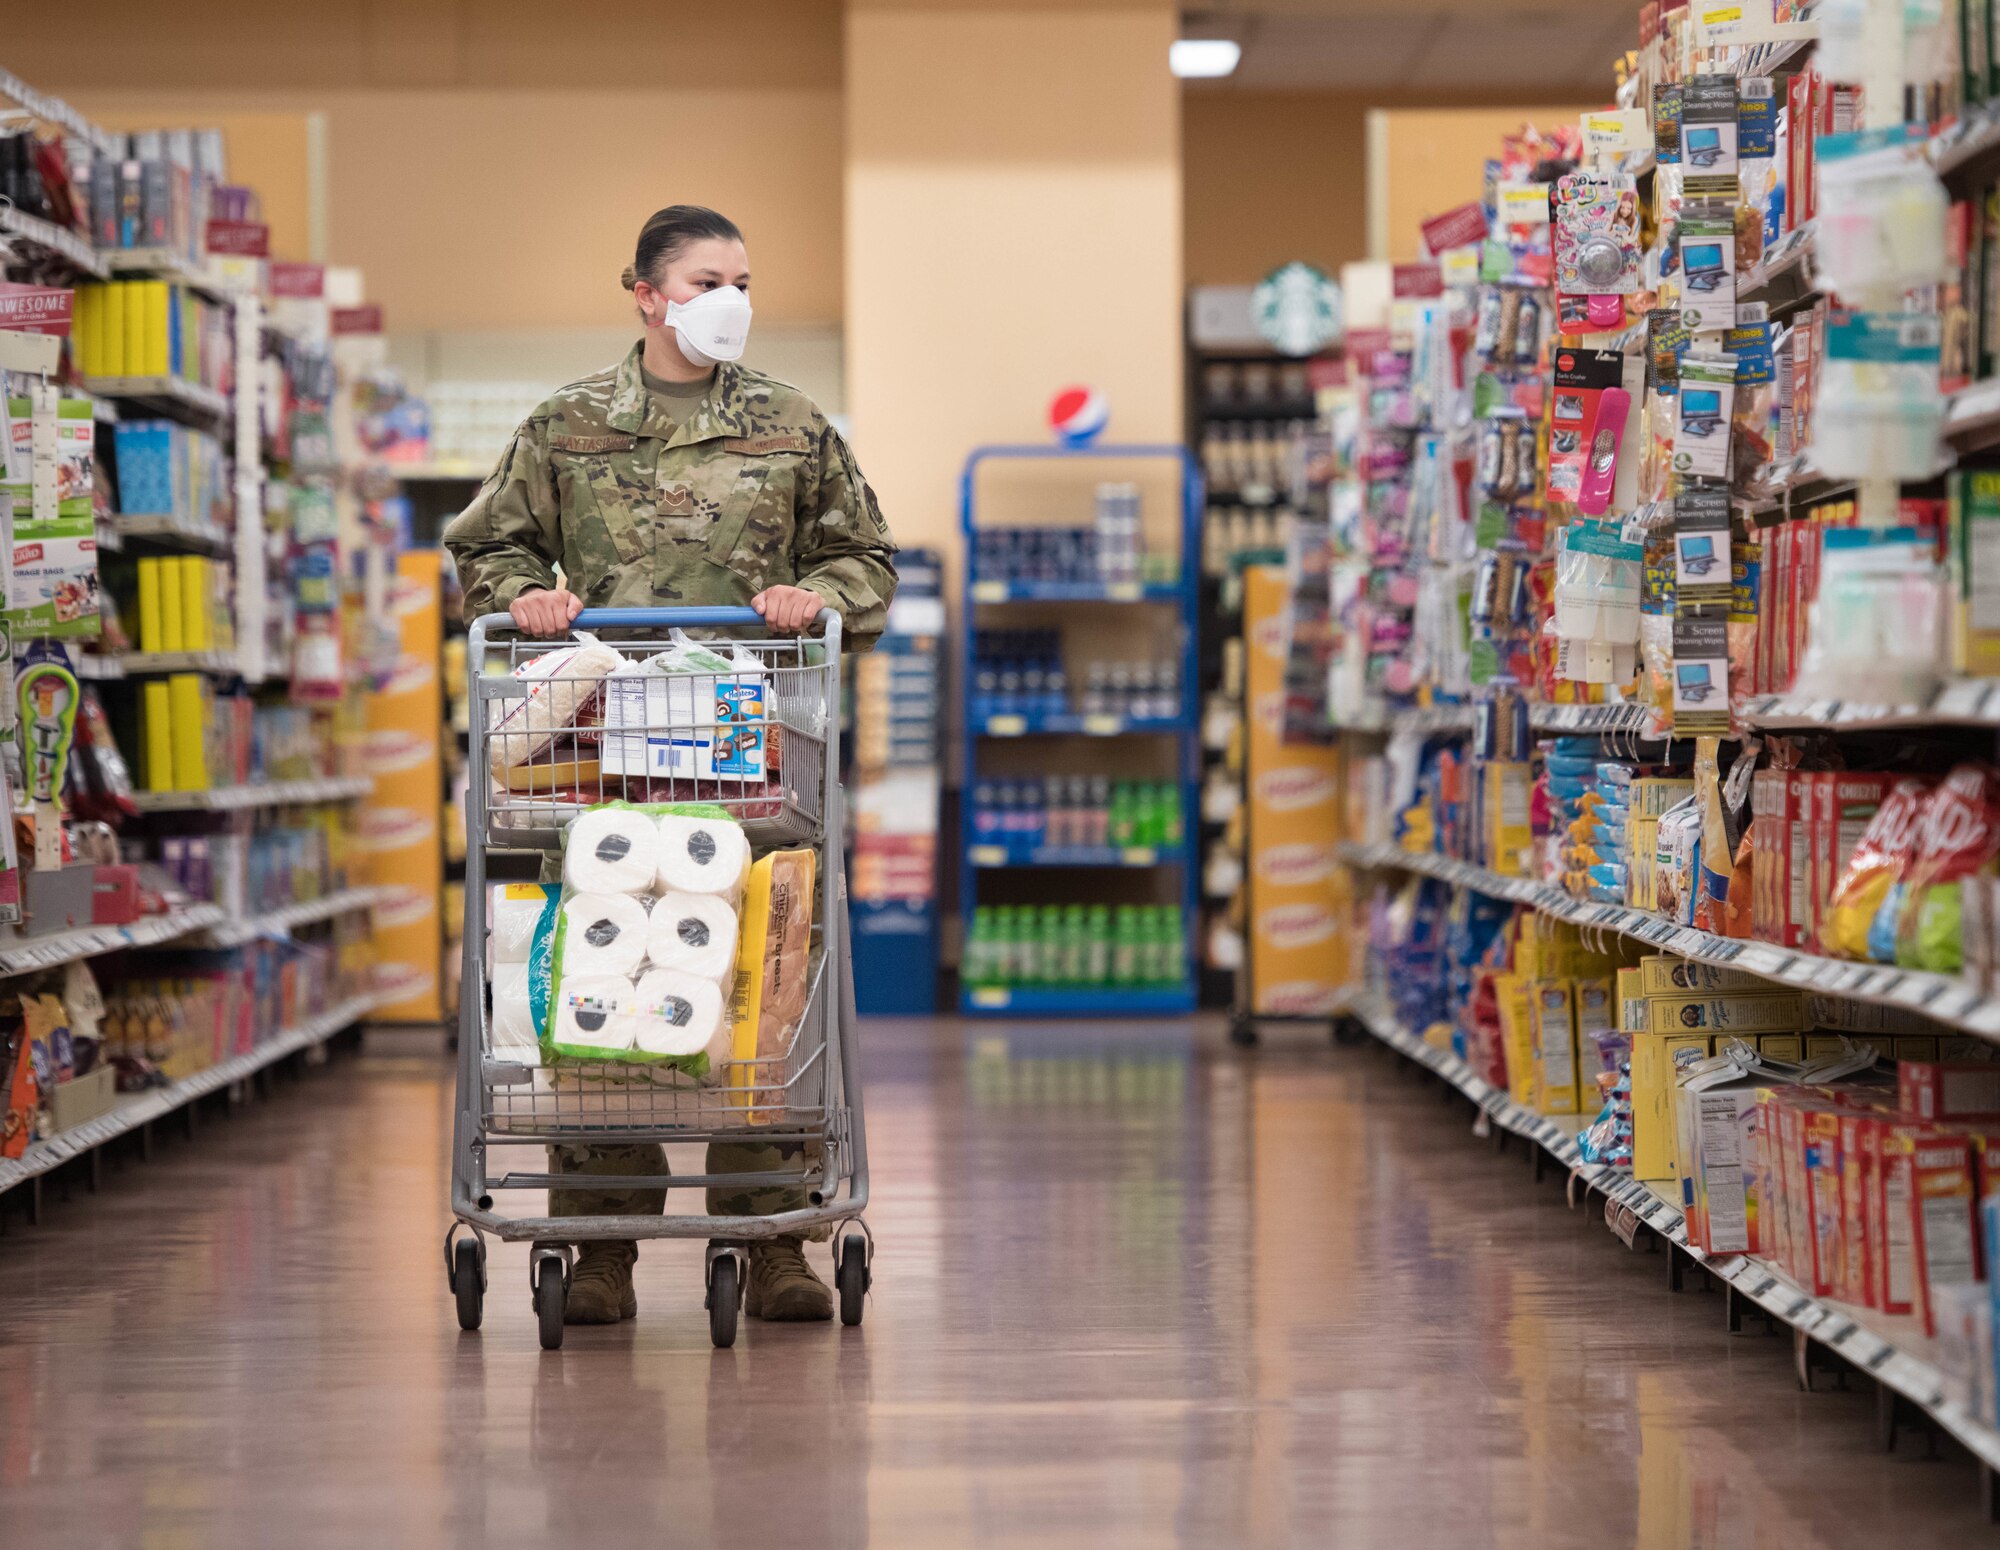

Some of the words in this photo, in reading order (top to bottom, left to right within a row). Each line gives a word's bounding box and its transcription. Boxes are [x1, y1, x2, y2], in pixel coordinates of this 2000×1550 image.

[1702, 89, 1734, 99] Screen
[1683, 101, 1712, 110] Cleaning
[1713, 101, 1735, 109] Wipes
[1704, 221, 1734, 230] Cleaning
[714, 336, 729, 345] 3M
[1705, 366, 1735, 377] Cleaning
[1693, 498, 1727, 508] Screen
[1676, 510, 1706, 519] Cleaning
[1706, 510, 1727, 518] Wipes
[42, 567, 64, 576] BAGS
[1692, 625, 1725, 636] Screen
[1674, 637, 1704, 646] Cleaning
[1704, 638, 1725, 646] Wipes
[776, 884, 787, 940] Chicken
[773, 943, 783, 996] Breasts
[1710, 1000, 1724, 1031] Famous
[1675, 1047, 1703, 1062] Famous
[1681, 1056, 1704, 1068] Amos
